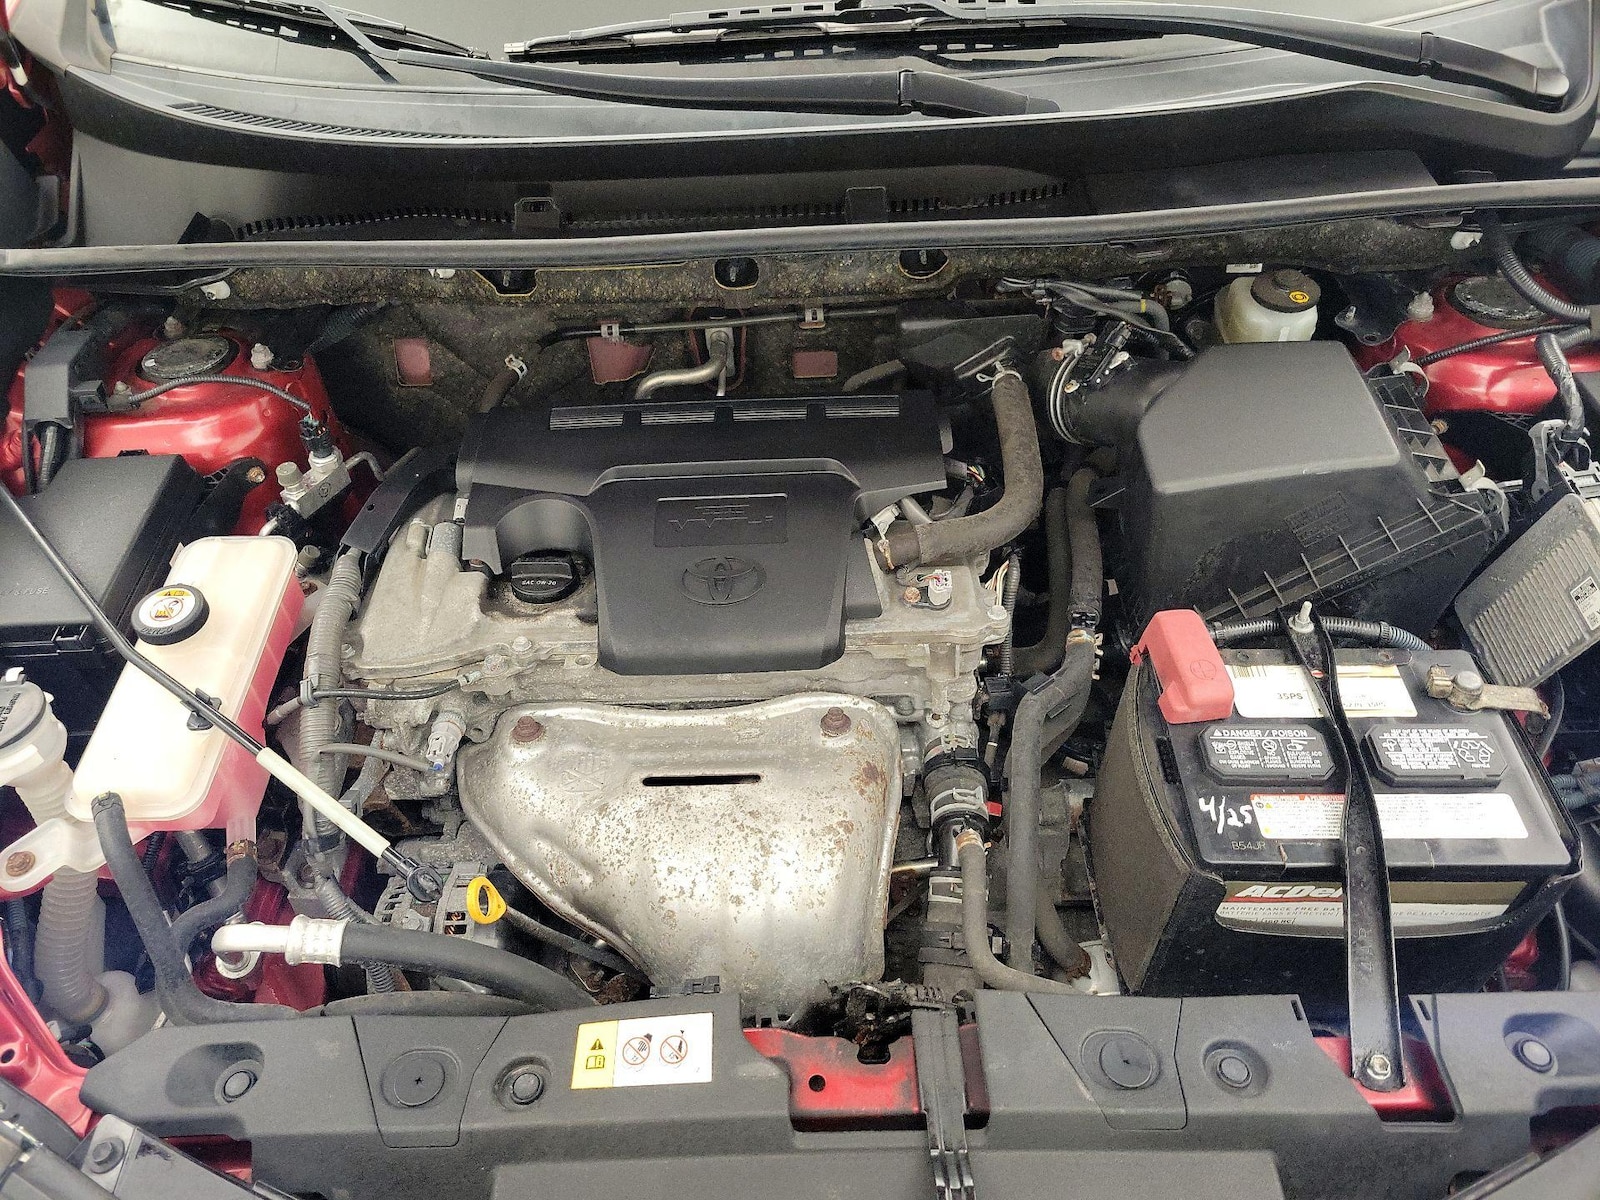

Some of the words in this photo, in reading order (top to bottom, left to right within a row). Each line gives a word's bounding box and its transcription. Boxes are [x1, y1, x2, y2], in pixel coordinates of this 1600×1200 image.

[140, 626, 174, 635] DENSO
[1278, 693, 1304, 701] 35PS
[1198, 795, 1253, 834] 4/25
[1234, 885, 1343, 898] ACDel
